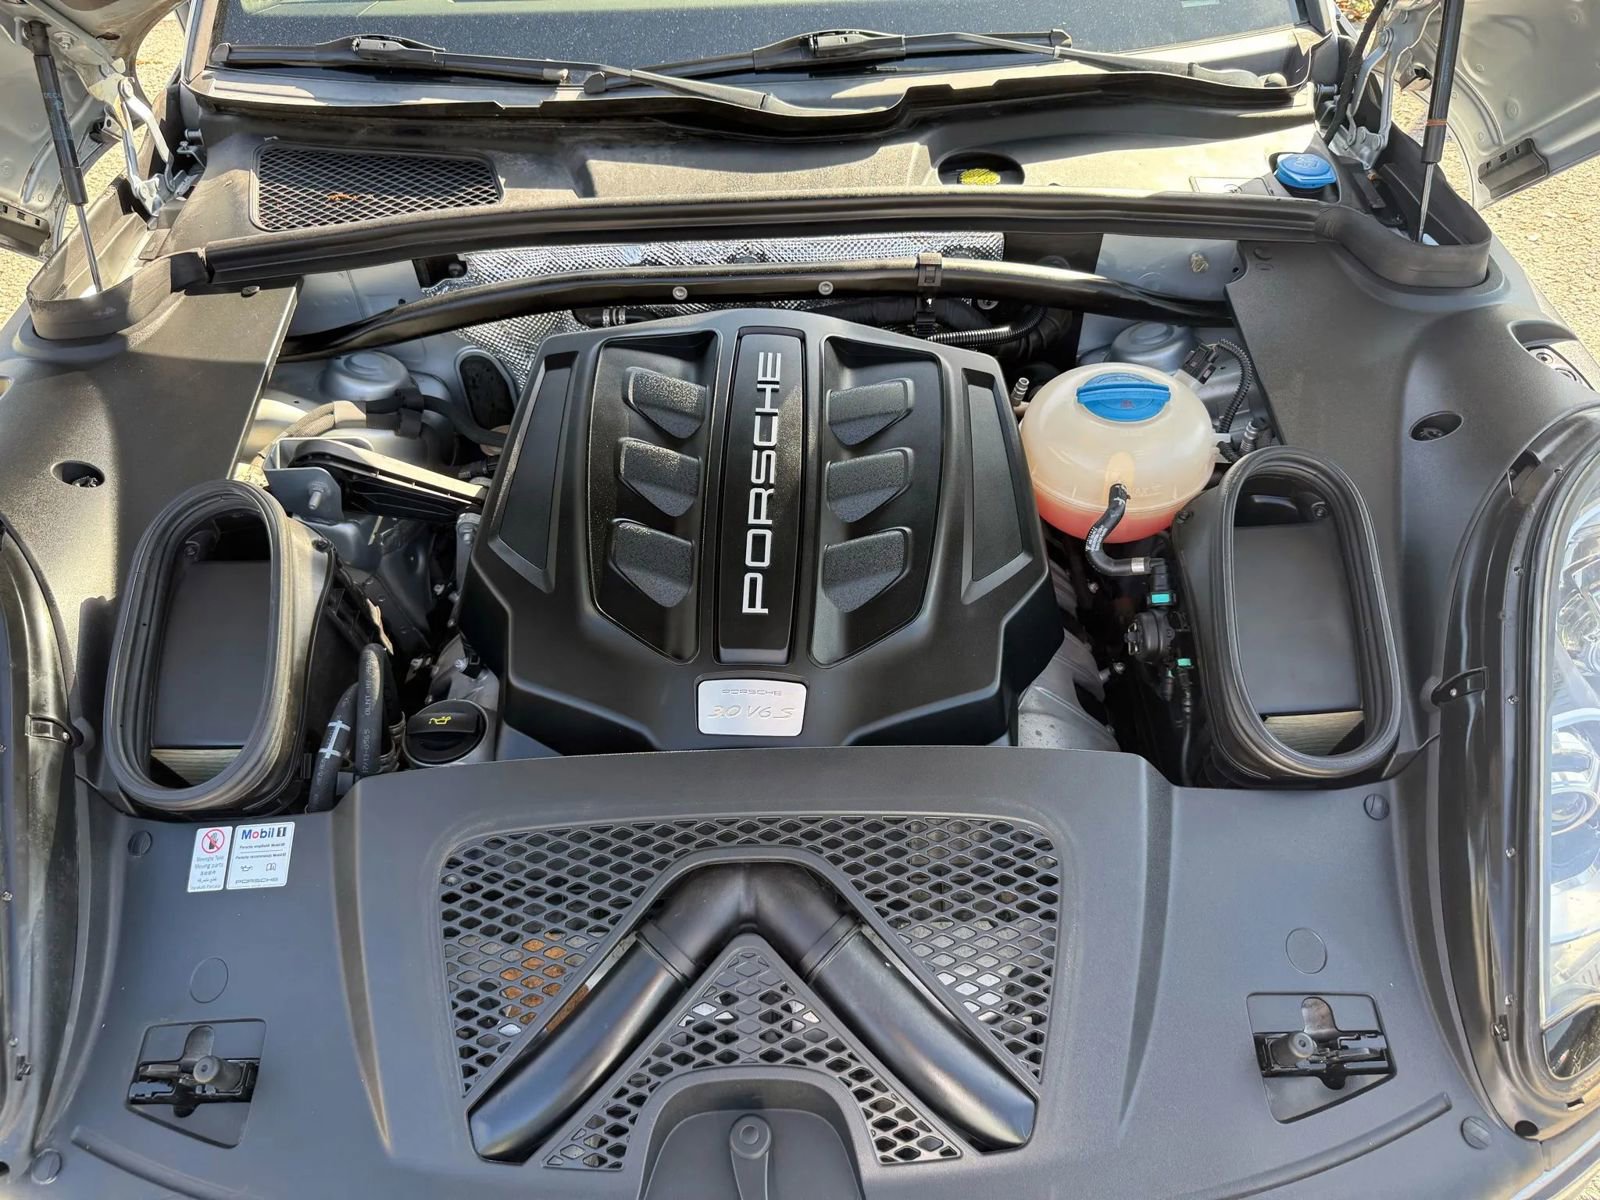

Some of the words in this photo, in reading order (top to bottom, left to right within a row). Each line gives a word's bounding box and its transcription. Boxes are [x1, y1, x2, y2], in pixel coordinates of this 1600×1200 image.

[742, 352, 782, 614] PORSCHE
[722, 688, 782, 697] PORSCHE
[708, 704, 741, 718] 3.0
[747, 705, 772, 718] V6
[773, 707, 795, 718] S
[241, 827, 274, 840] Mobil
[277, 827, 287, 838] 1
